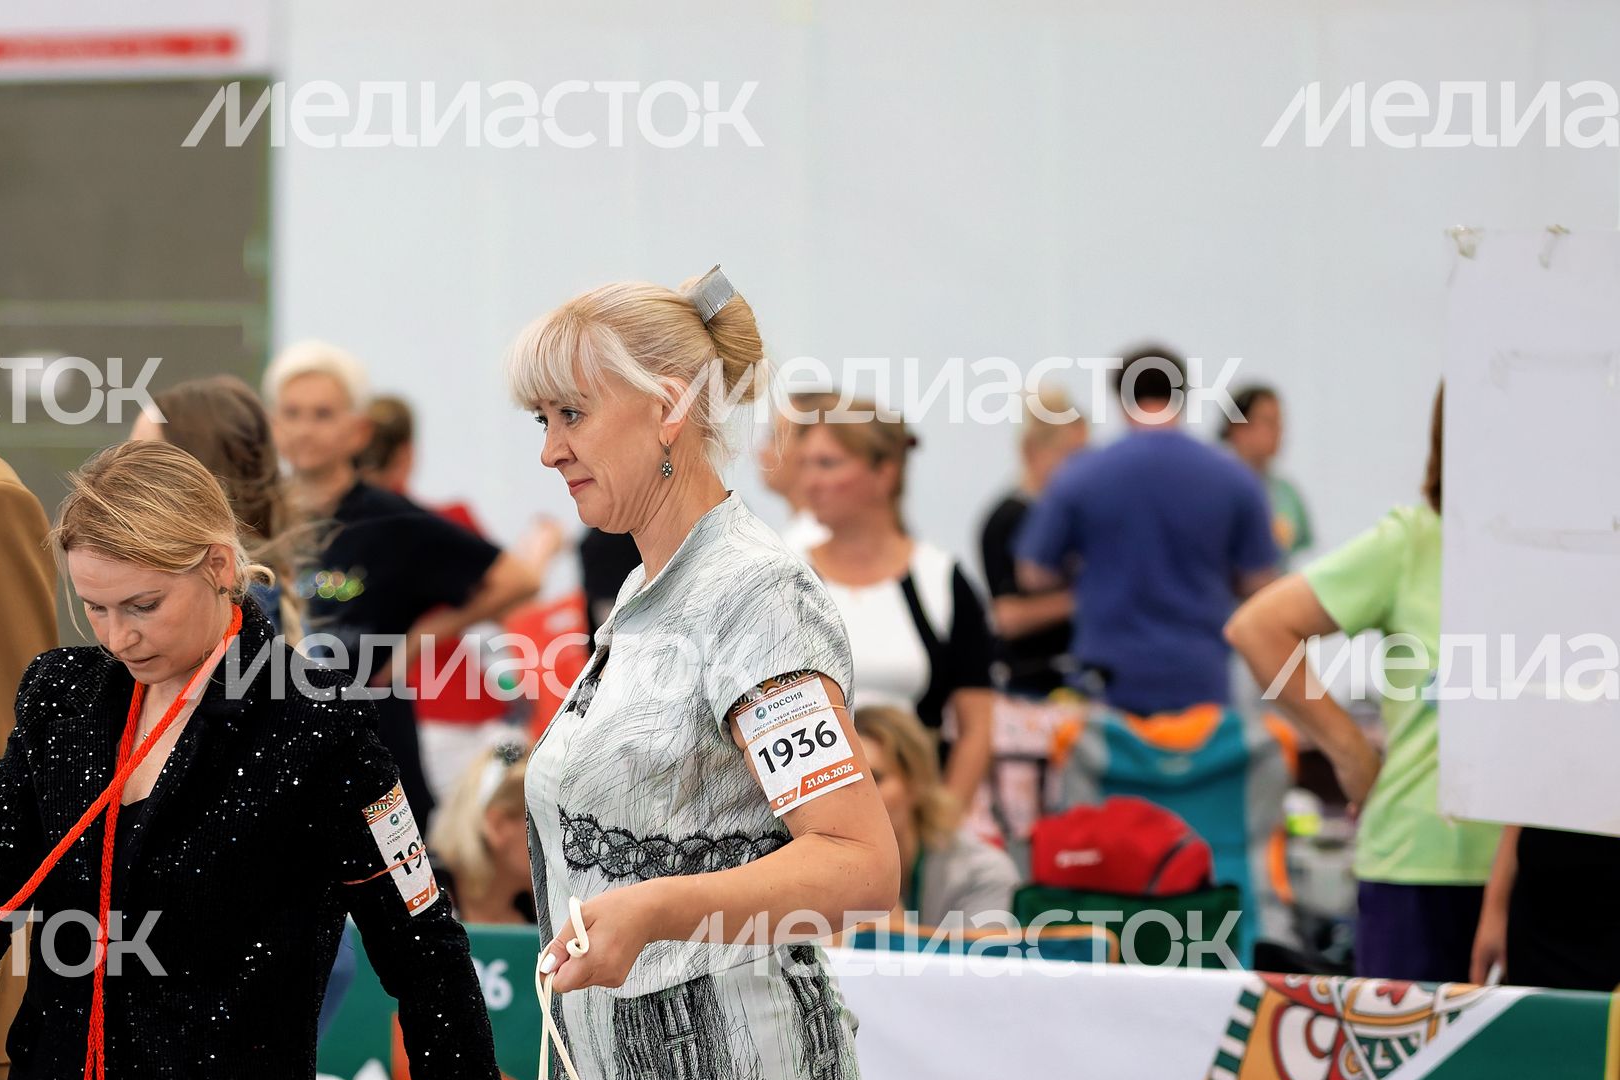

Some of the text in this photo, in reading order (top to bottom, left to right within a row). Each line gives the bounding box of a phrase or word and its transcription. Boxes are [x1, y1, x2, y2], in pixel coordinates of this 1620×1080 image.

[766, 689, 803, 712] РОССИЯ
[758, 720, 838, 774] 1936
[805, 762, 854, 789] 21.06.2026
[393, 835, 427, 876] 19
